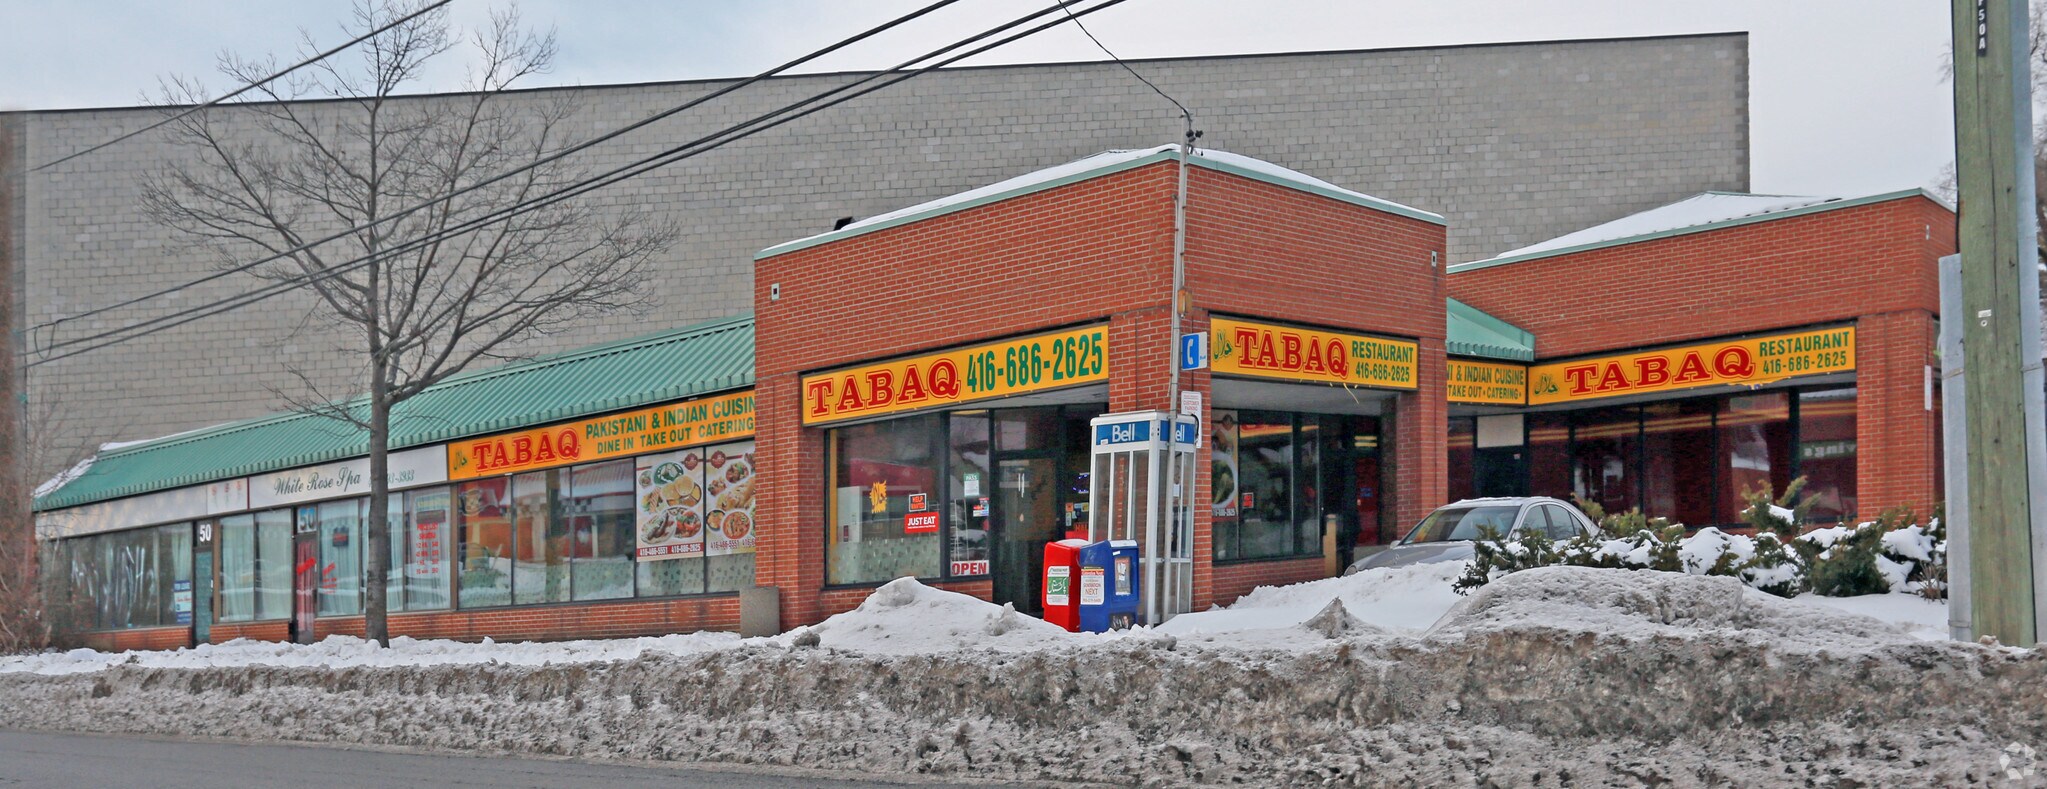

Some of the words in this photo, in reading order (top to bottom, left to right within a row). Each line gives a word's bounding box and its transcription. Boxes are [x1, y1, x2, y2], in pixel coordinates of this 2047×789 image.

[1235, 326, 1349, 380] TABAQ
[1352, 340, 1414, 363] RESTAURANT
[1759, 331, 1850, 357] RESTAURANT
[1356, 361, 1410, 382] 416-686-2625
[1564, 346, 1756, 397] TABAQ
[1763, 350, 1848, 375] 416-686-2625
[807, 358, 962, 418] TABAQ
[967, 332, 1103, 392] 416-686-2625
[1456, 365, 1463, 382] &
[1464, 365, 1493, 384] INDIAN
[1494, 367, 1525, 386] CUISINE
[1448, 384, 1466, 397] TAKE
[1468, 386, 1482, 398] OUT
[1486, 387, 1518, 400] CATERING
[586, 415, 646, 440] PAKISTANI
[651, 412, 661, 429] &
[664, 404, 708, 427] INDIAN
[1112, 424, 1135, 442] Bell
[1175, 424, 1185, 442] ell
[597, 438, 621, 455] DINE
[623, 437, 634, 450] IN
[640, 431, 667, 448] TAKE
[669, 427, 692, 443] OUT
[698, 416, 755, 438] CATERING
[472, 428, 582, 473] TABAQ
[274, 476, 304, 496] White
[307, 471, 334, 492] Rose
[337, 466, 362, 492] Spa
[300, 507, 315, 530] 50
[907, 517, 923, 526] JUST
[924, 516, 936, 525] EAT
[199, 524, 212, 542] 50
[951, 562, 987, 575] OPEN
